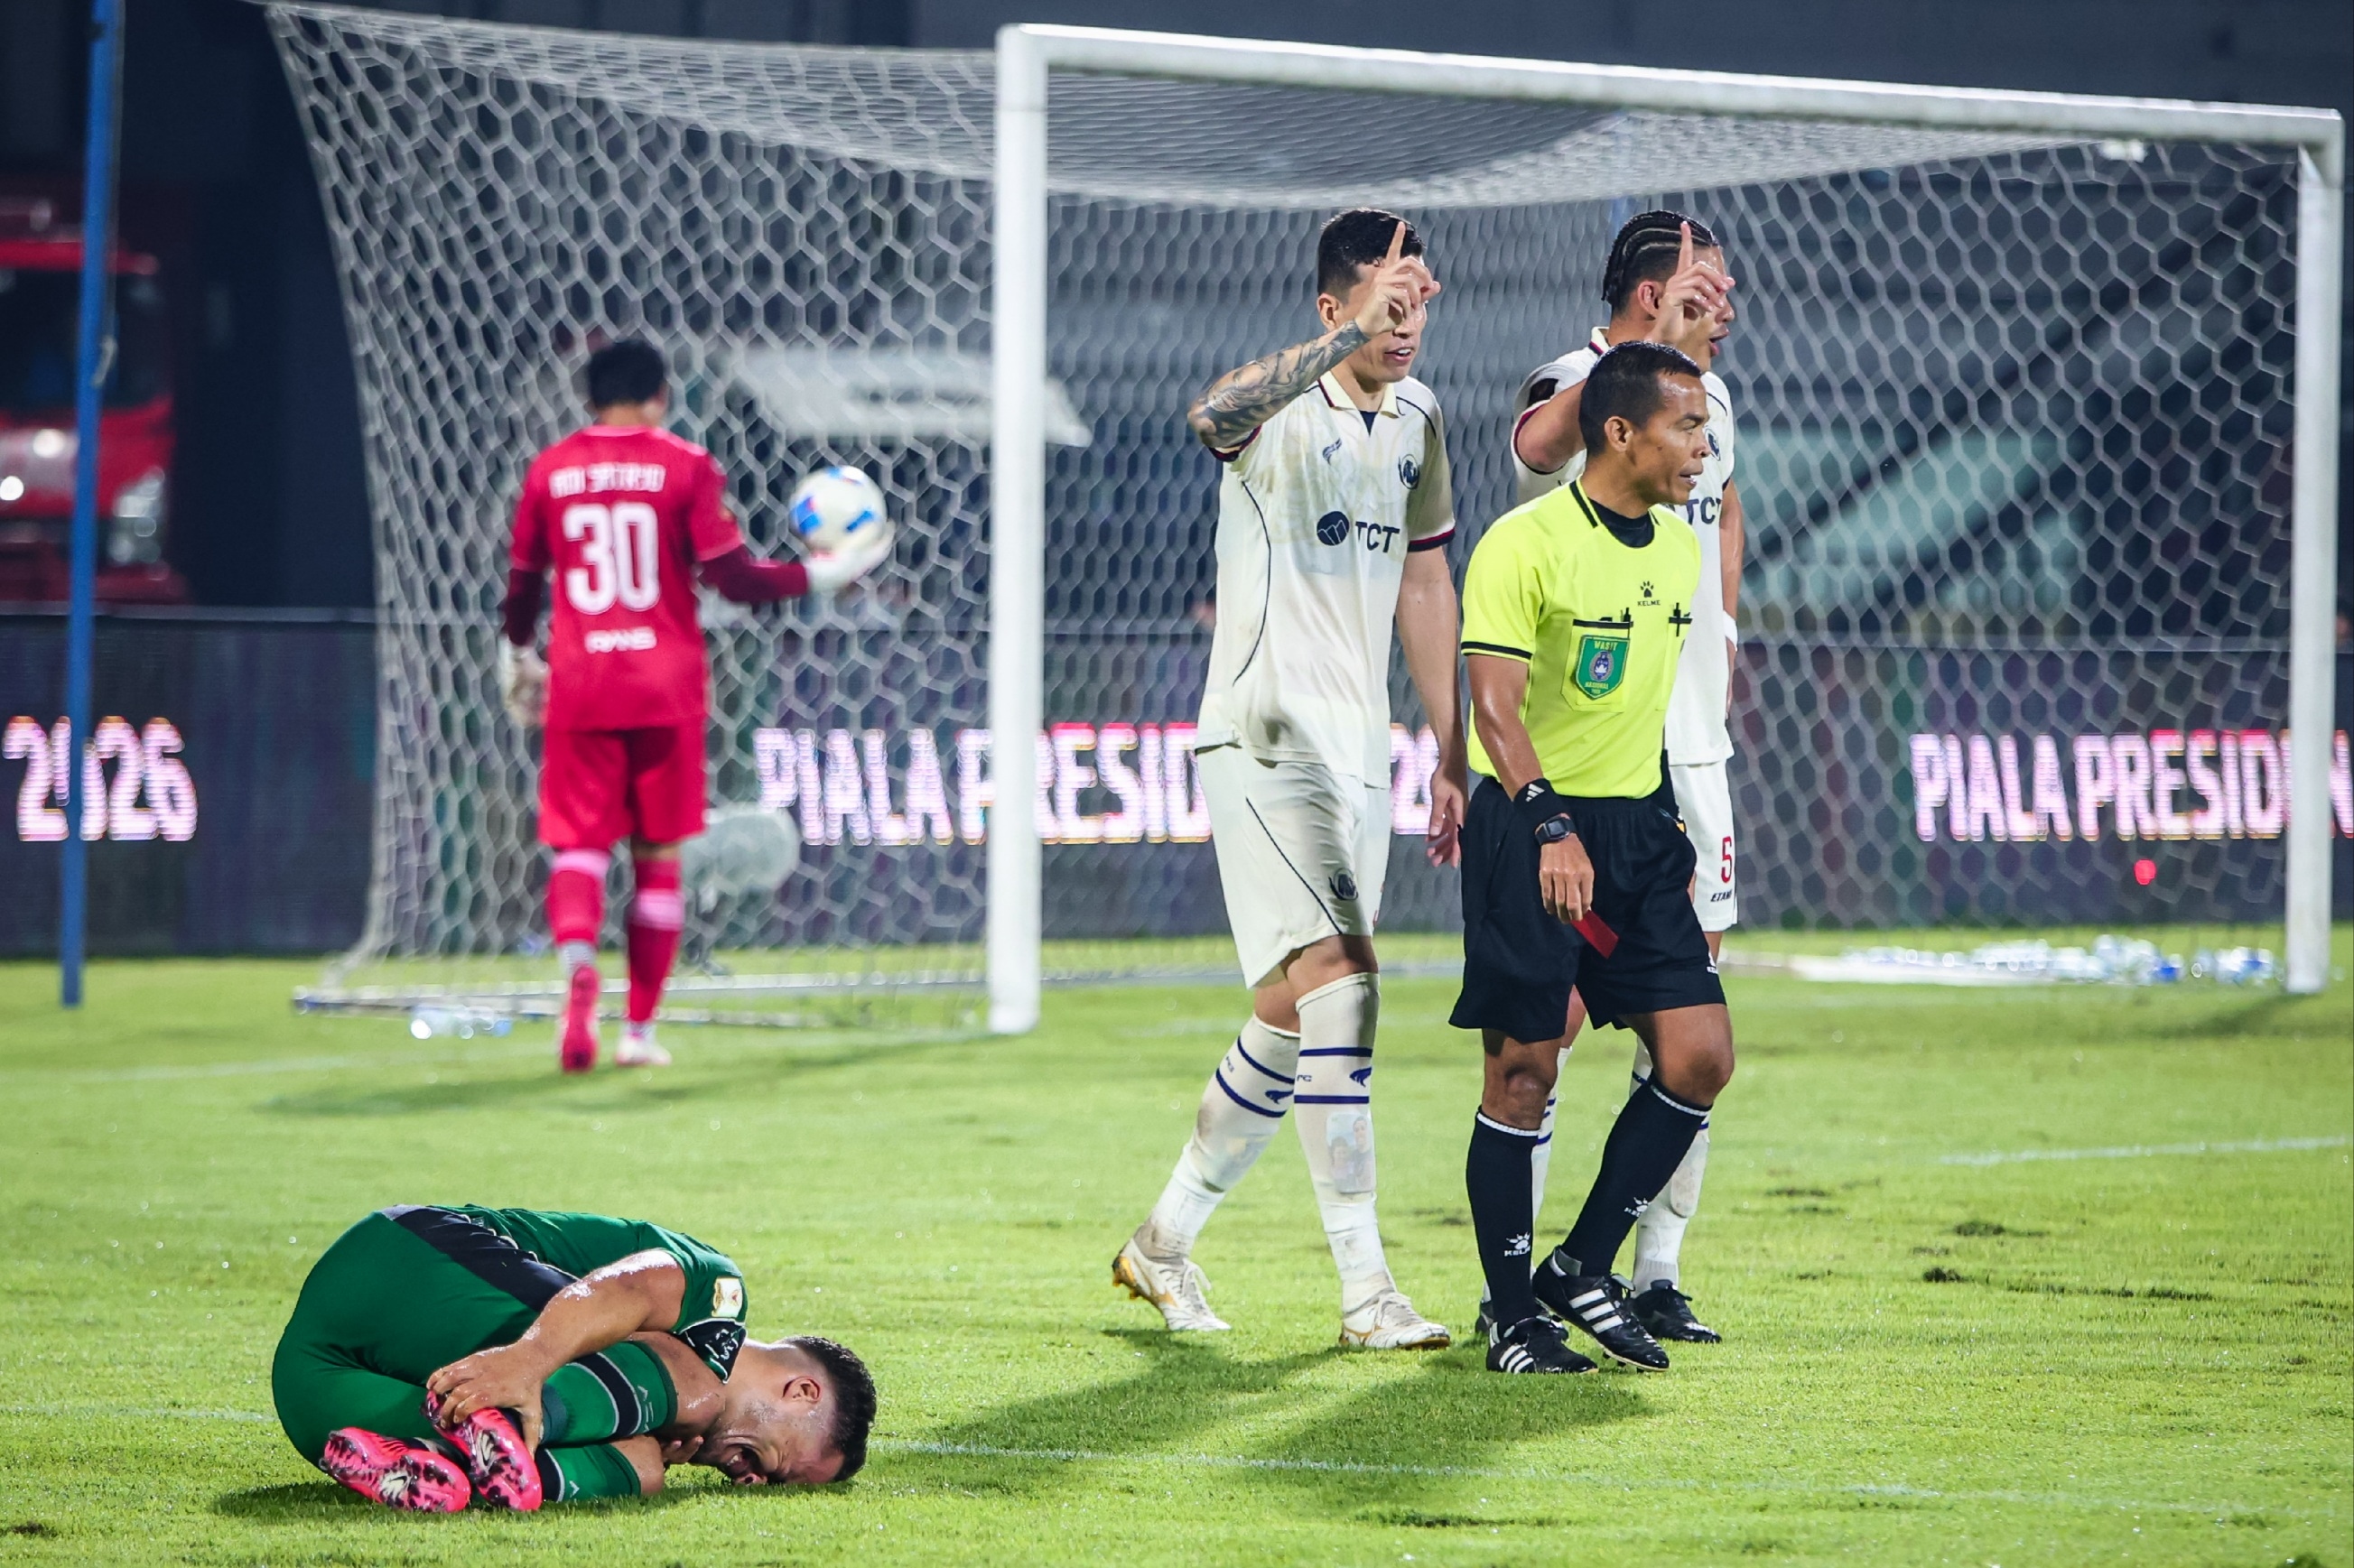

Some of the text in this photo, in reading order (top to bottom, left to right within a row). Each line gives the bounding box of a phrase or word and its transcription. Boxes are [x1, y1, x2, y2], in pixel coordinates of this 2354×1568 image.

[563, 502, 660, 615] 30
[1355, 521, 1400, 552] TCT
[1594, 640, 1618, 650] WASIT
[2, 716, 198, 841] 2026
[751, 728, 954, 845] PIALA
[1910, 733, 2072, 841] PIALA
[1721, 836, 1732, 884] 5
